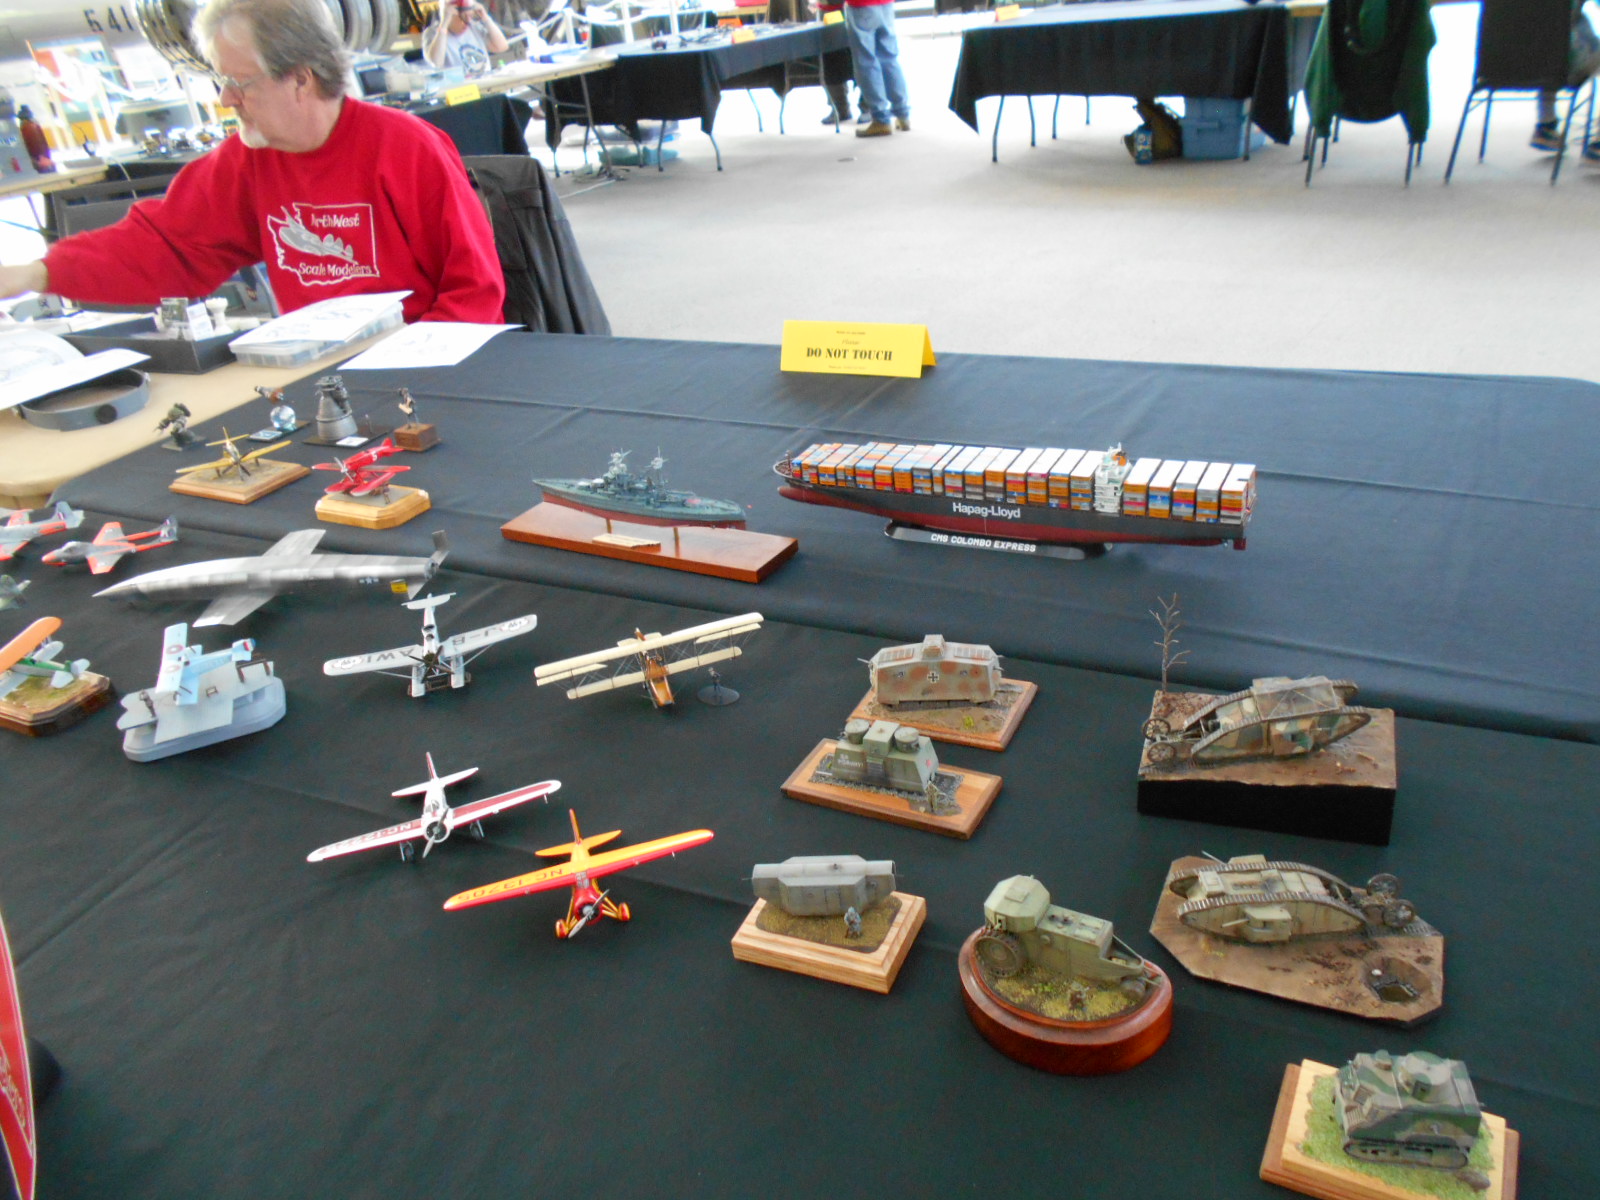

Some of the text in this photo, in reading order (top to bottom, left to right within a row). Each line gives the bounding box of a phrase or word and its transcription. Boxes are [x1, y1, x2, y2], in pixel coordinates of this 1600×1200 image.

[311, 212, 360, 228] NrthWest
[806, 346, 893, 361] DO NOT TOUCH
[952, 502, 1021, 519] Hapag-Lloyd
[951, 535, 992, 547] COLOMBO
[993, 540, 1037, 552] EXPRESS
